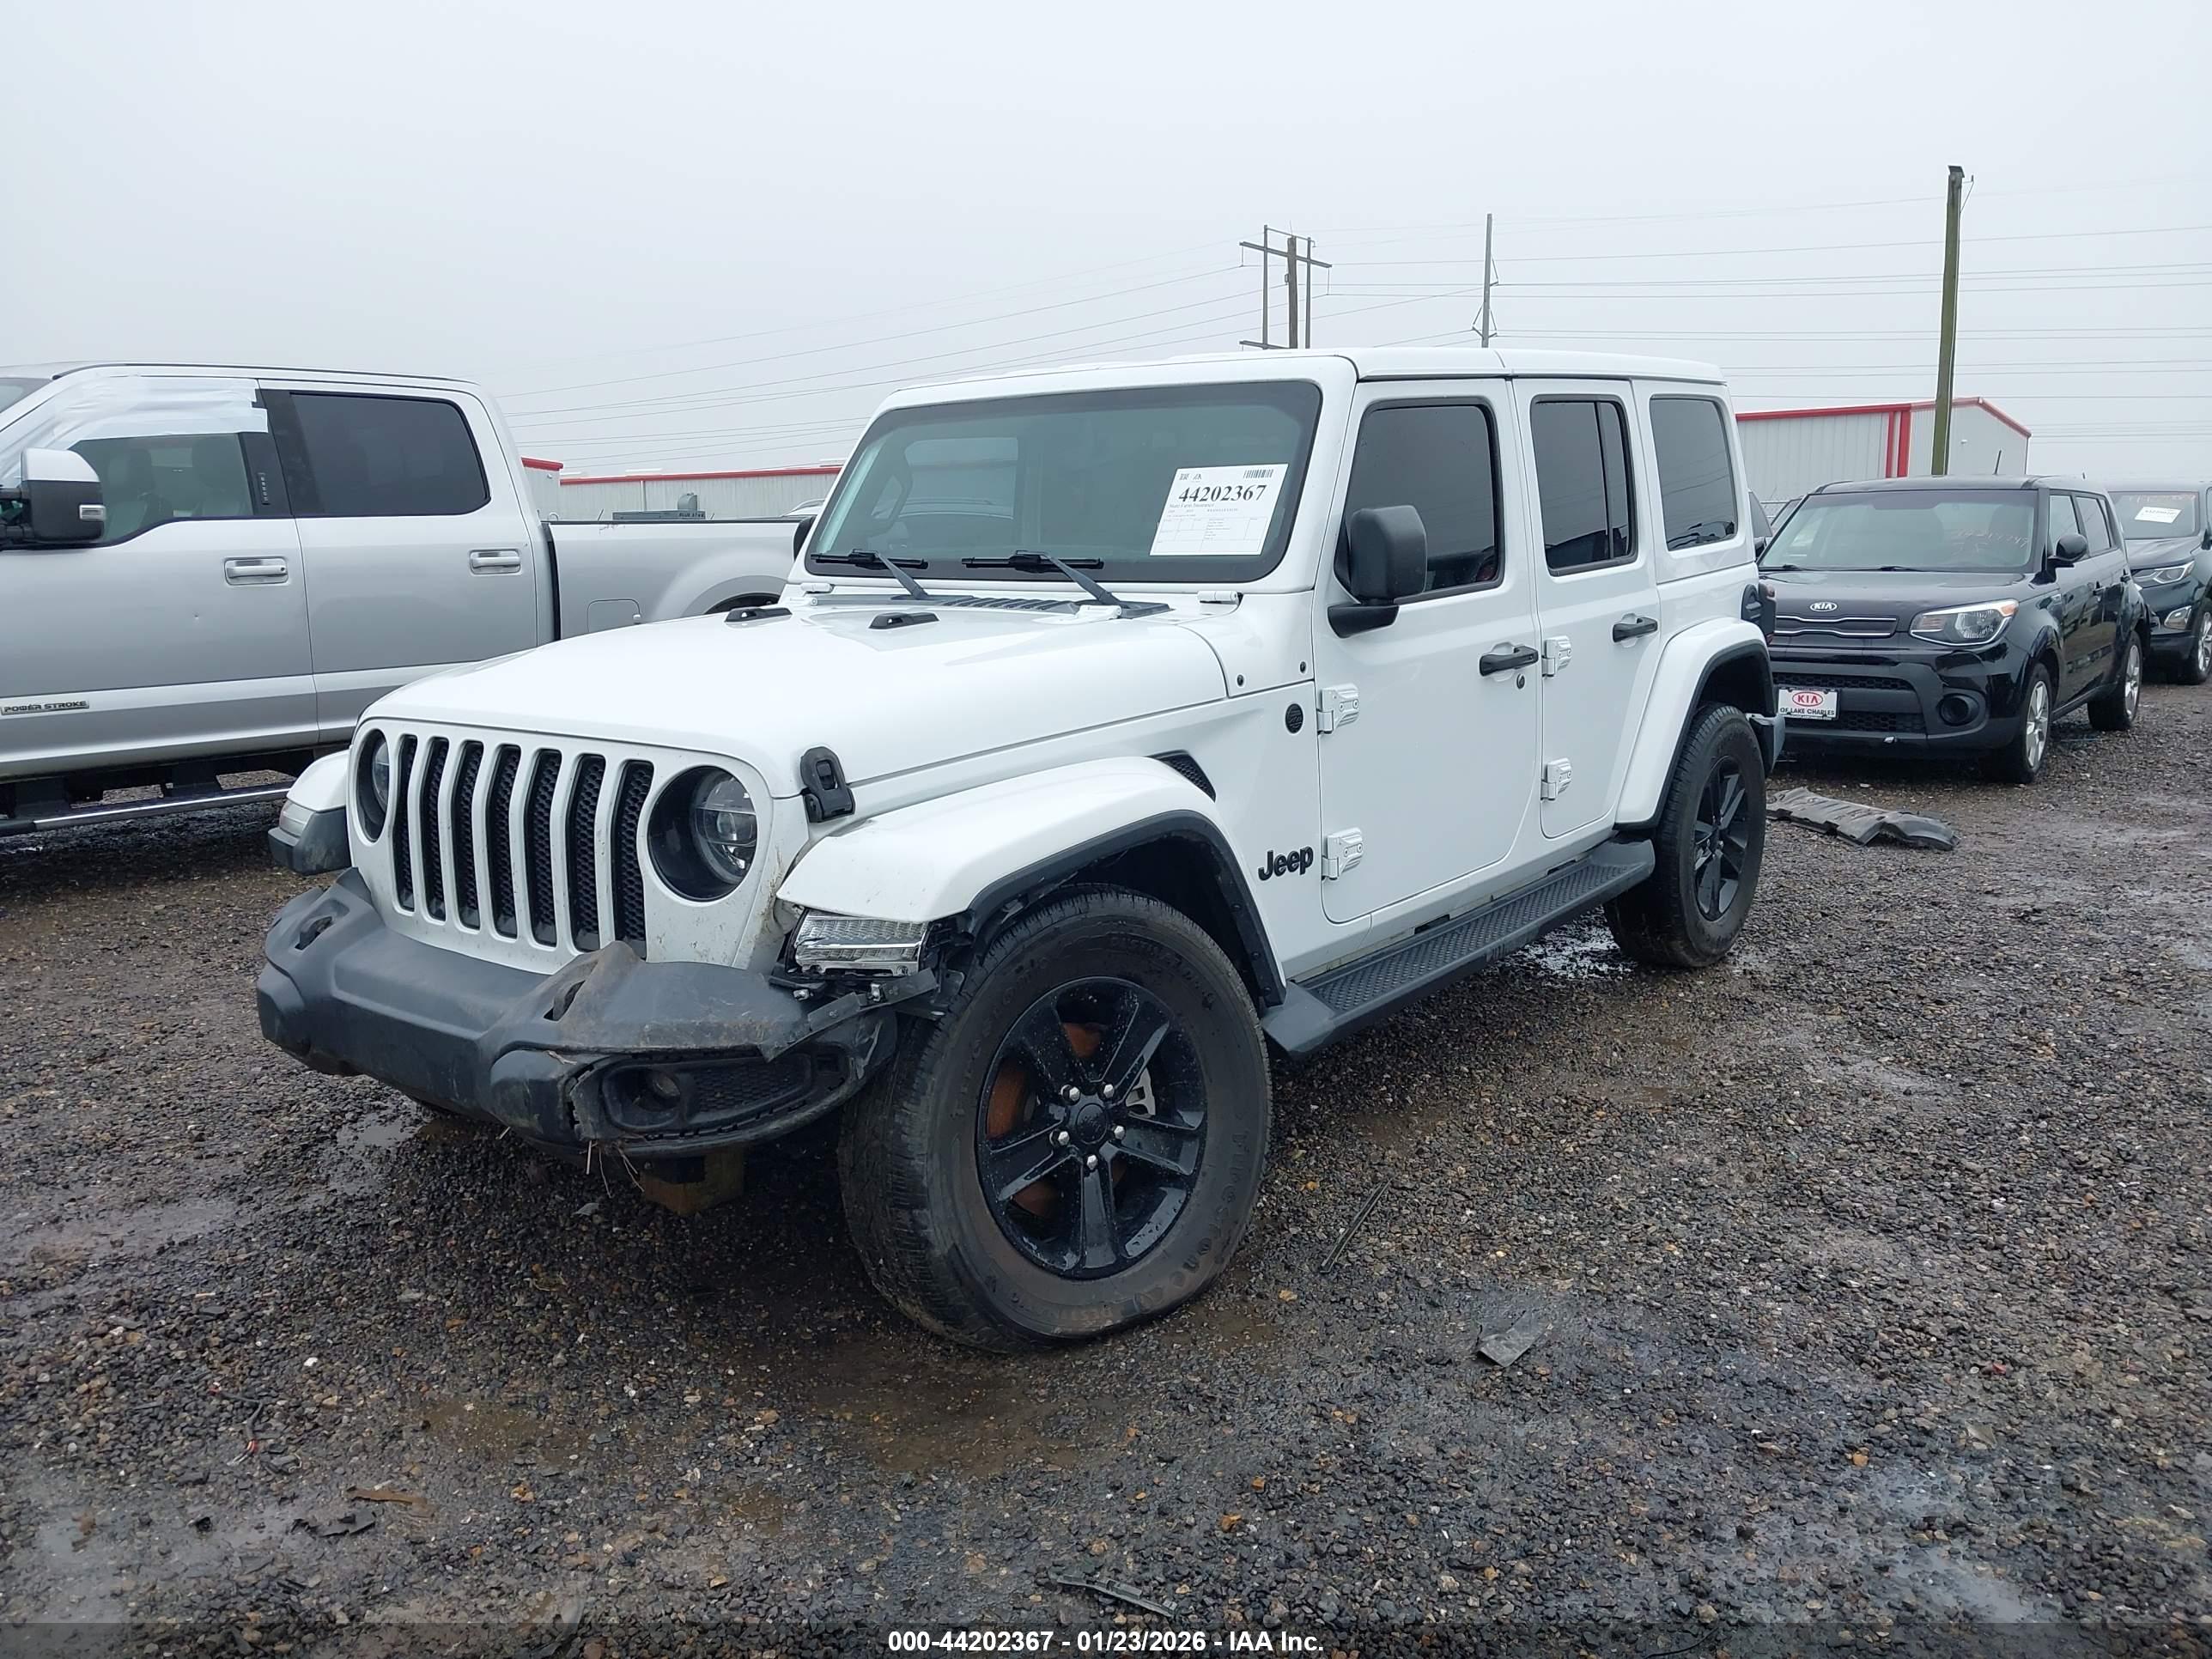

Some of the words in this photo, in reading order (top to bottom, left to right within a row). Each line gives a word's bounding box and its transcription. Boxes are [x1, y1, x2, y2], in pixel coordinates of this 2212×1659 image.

[1178, 484, 1267, 501] 44202367
[45, 701, 87, 709] STROKE
[1796, 695, 1819, 704] KIA
[1258, 846, 1314, 881] Jeep
